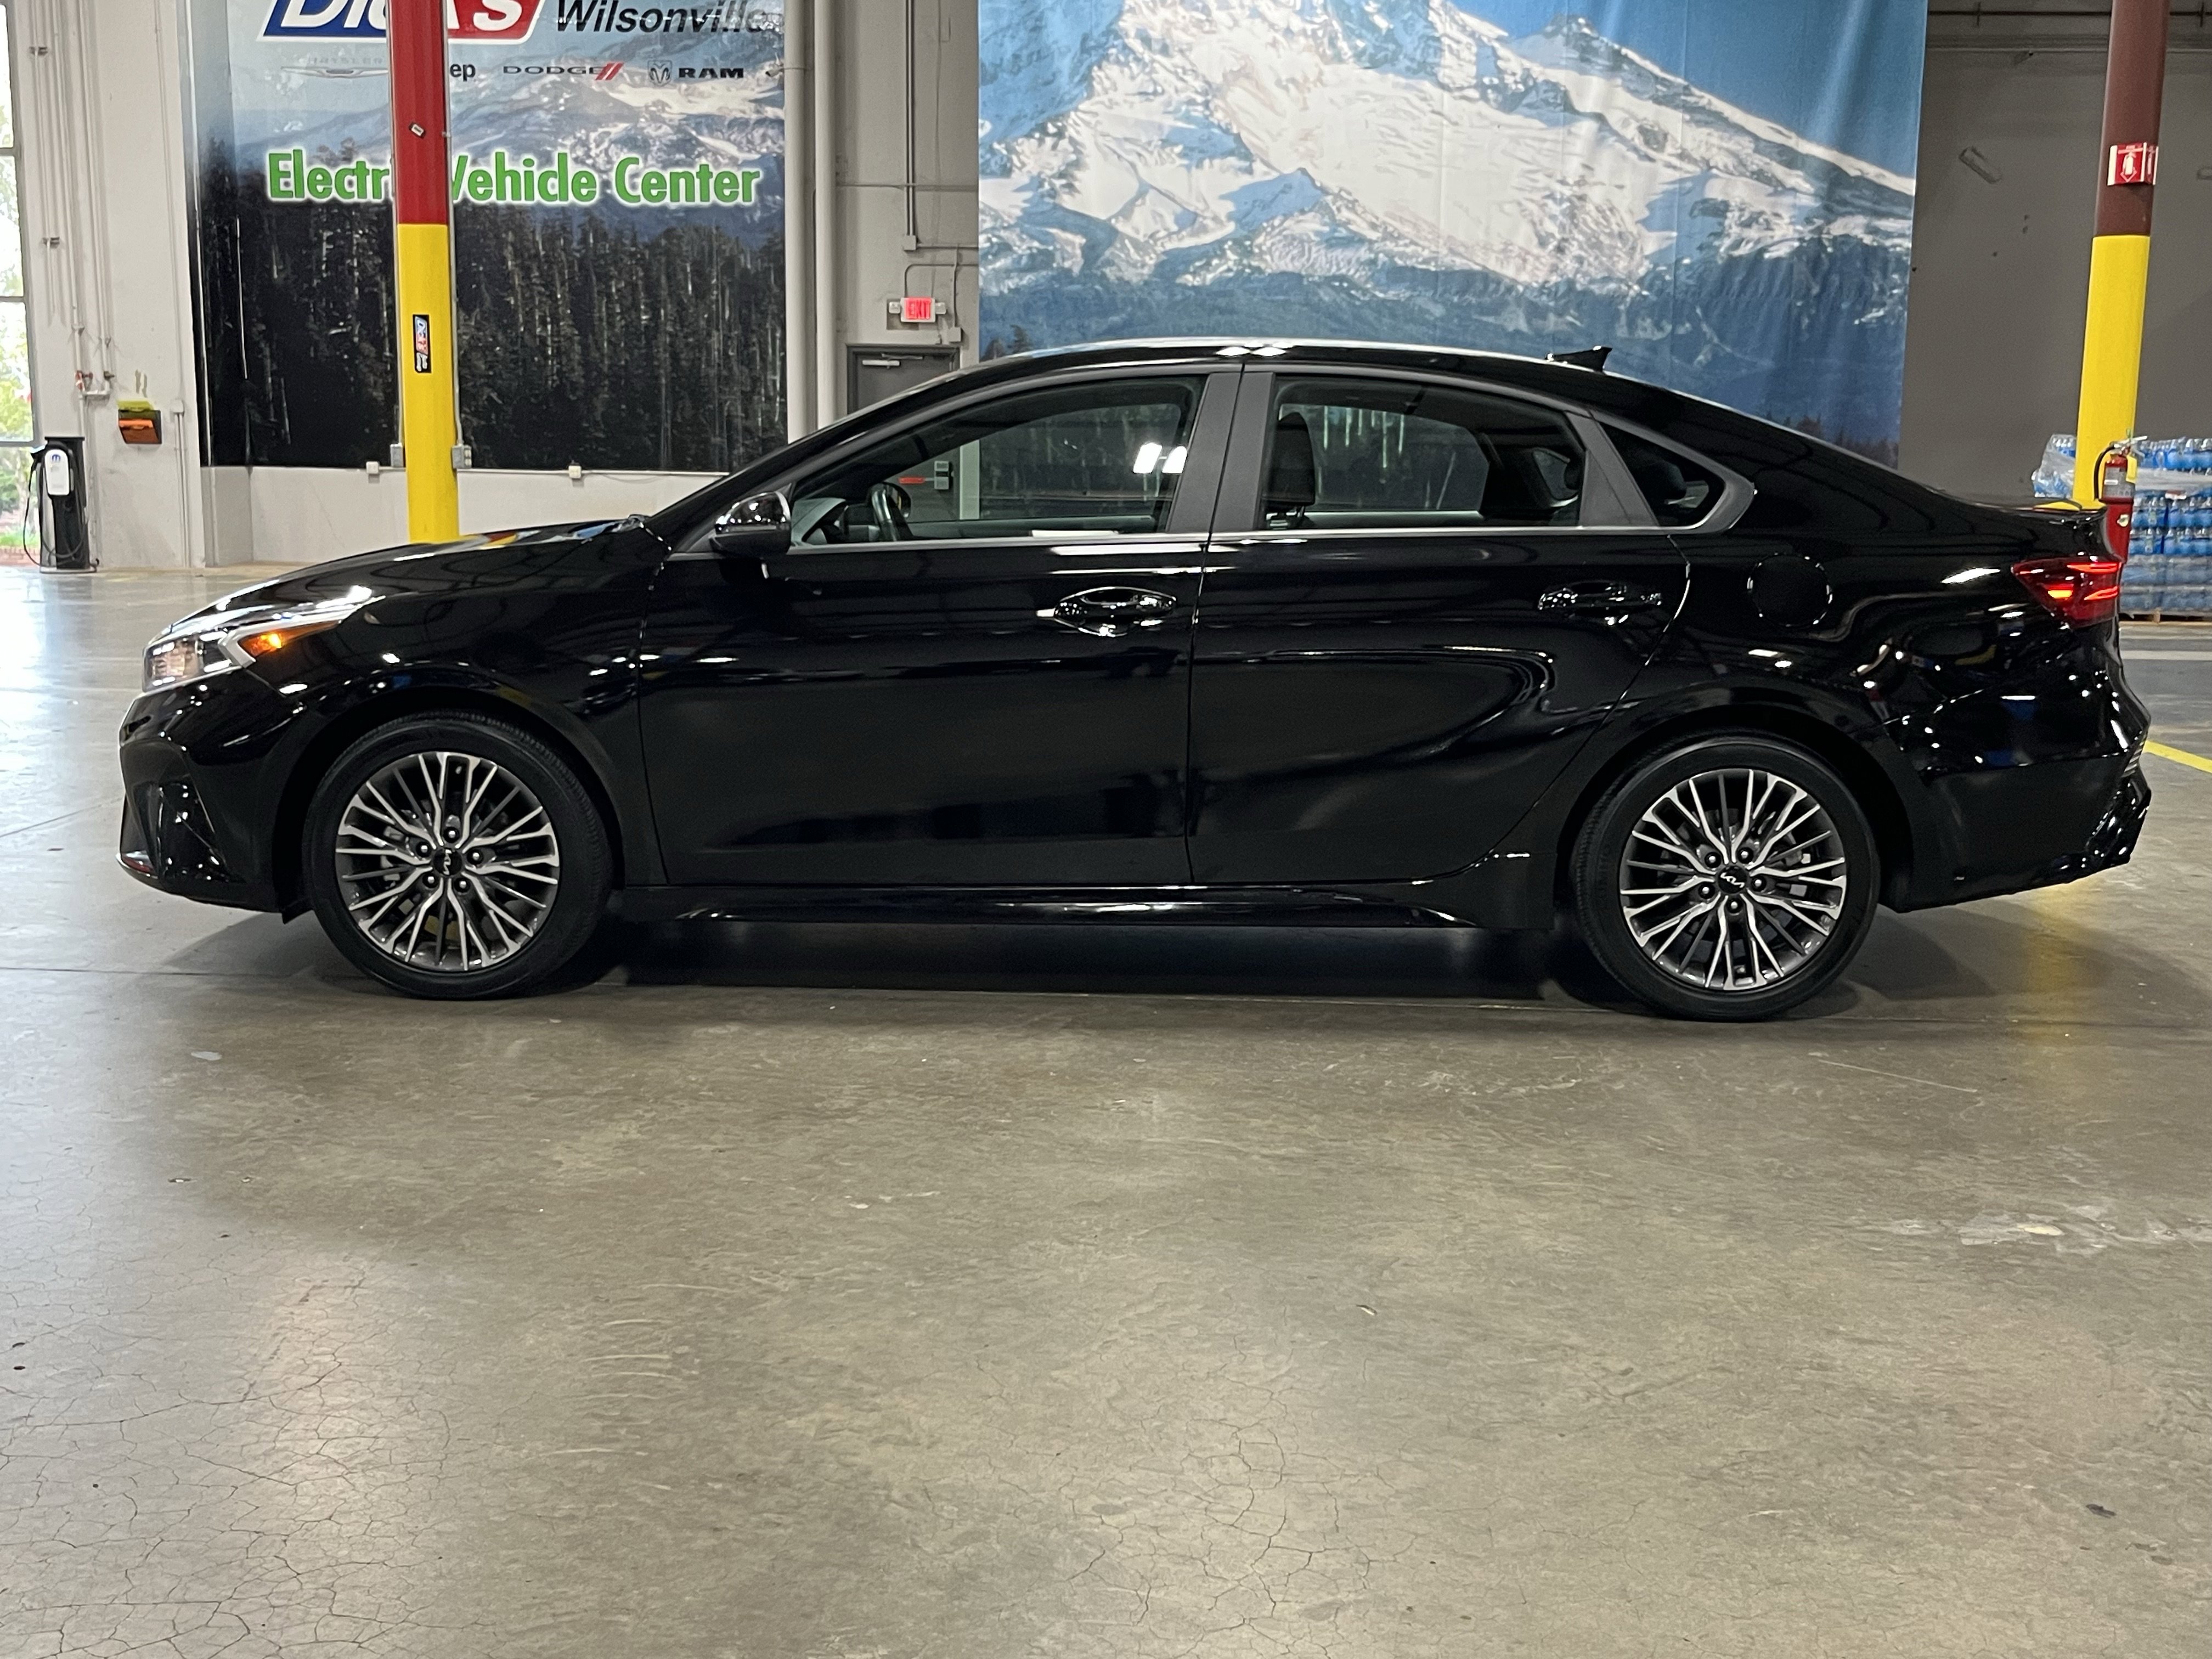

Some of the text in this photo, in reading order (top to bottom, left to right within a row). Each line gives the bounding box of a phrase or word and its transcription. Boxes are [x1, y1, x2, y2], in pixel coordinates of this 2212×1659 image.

[450, 63, 476, 82] ep
[504, 66, 603, 74] DODGE
[679, 67, 744, 78] RAM
[269, 149, 390, 199] Electr
[615, 157, 760, 202] Center
[906, 297, 931, 319] EXIT
